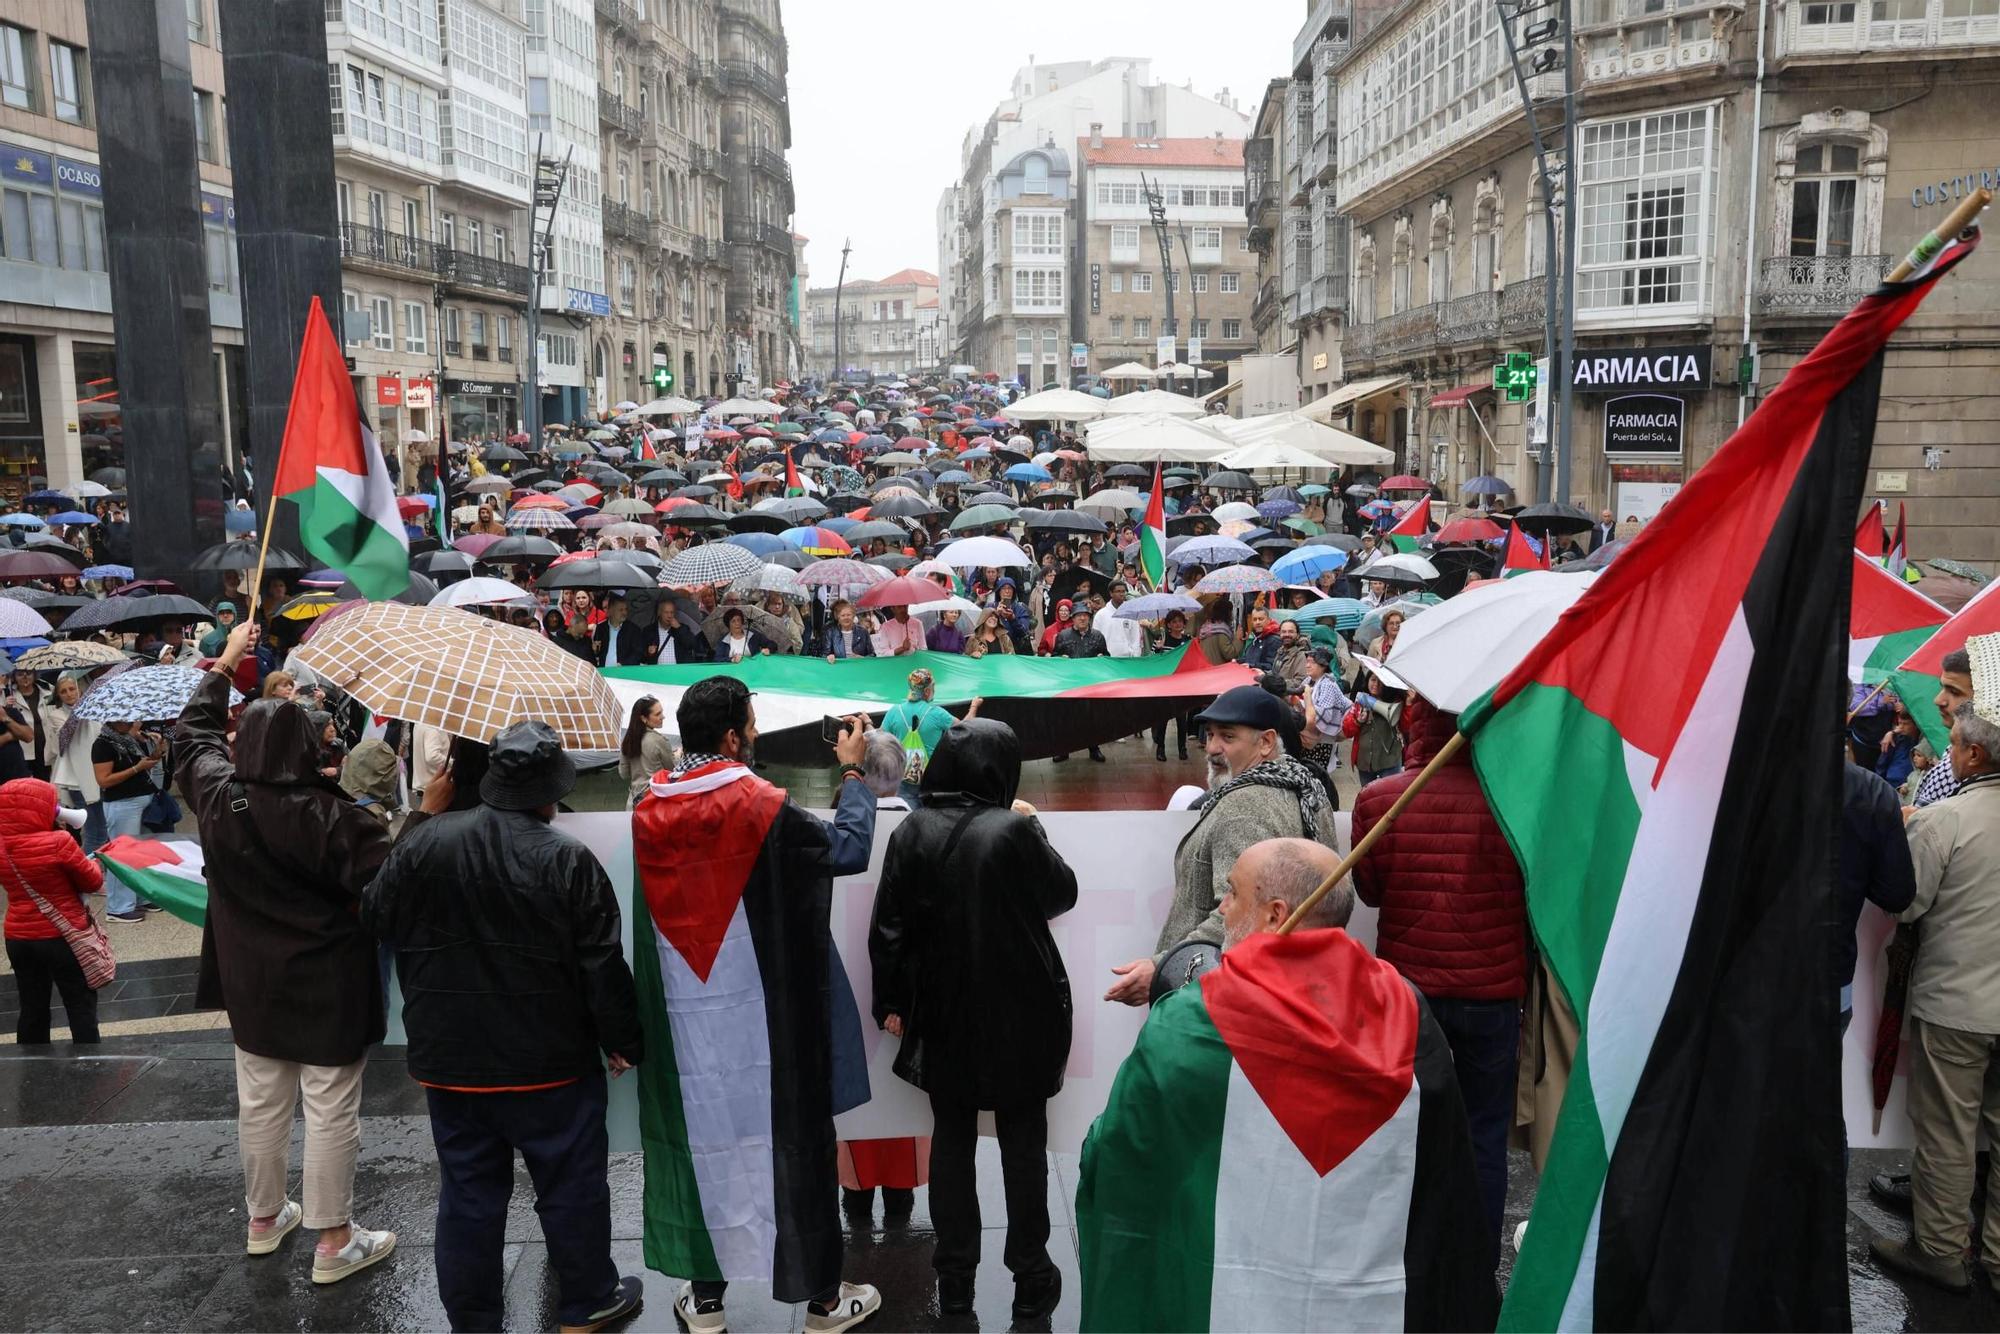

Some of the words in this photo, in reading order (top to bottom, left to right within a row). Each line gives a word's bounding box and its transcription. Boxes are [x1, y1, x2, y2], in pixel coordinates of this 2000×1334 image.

[58, 165, 100, 187] OCASO
[1571, 354, 1700, 385] ARMACIA
[461, 382, 469, 393] AS
[469, 383, 493, 395] Computer
[1609, 413, 1677, 428] FARMACIA
[1613, 432, 1637, 441] Puerta
[1639, 432, 1650, 441] del
[1652, 432, 1665, 443] Sol,
[1667, 434, 1672, 443] 4
